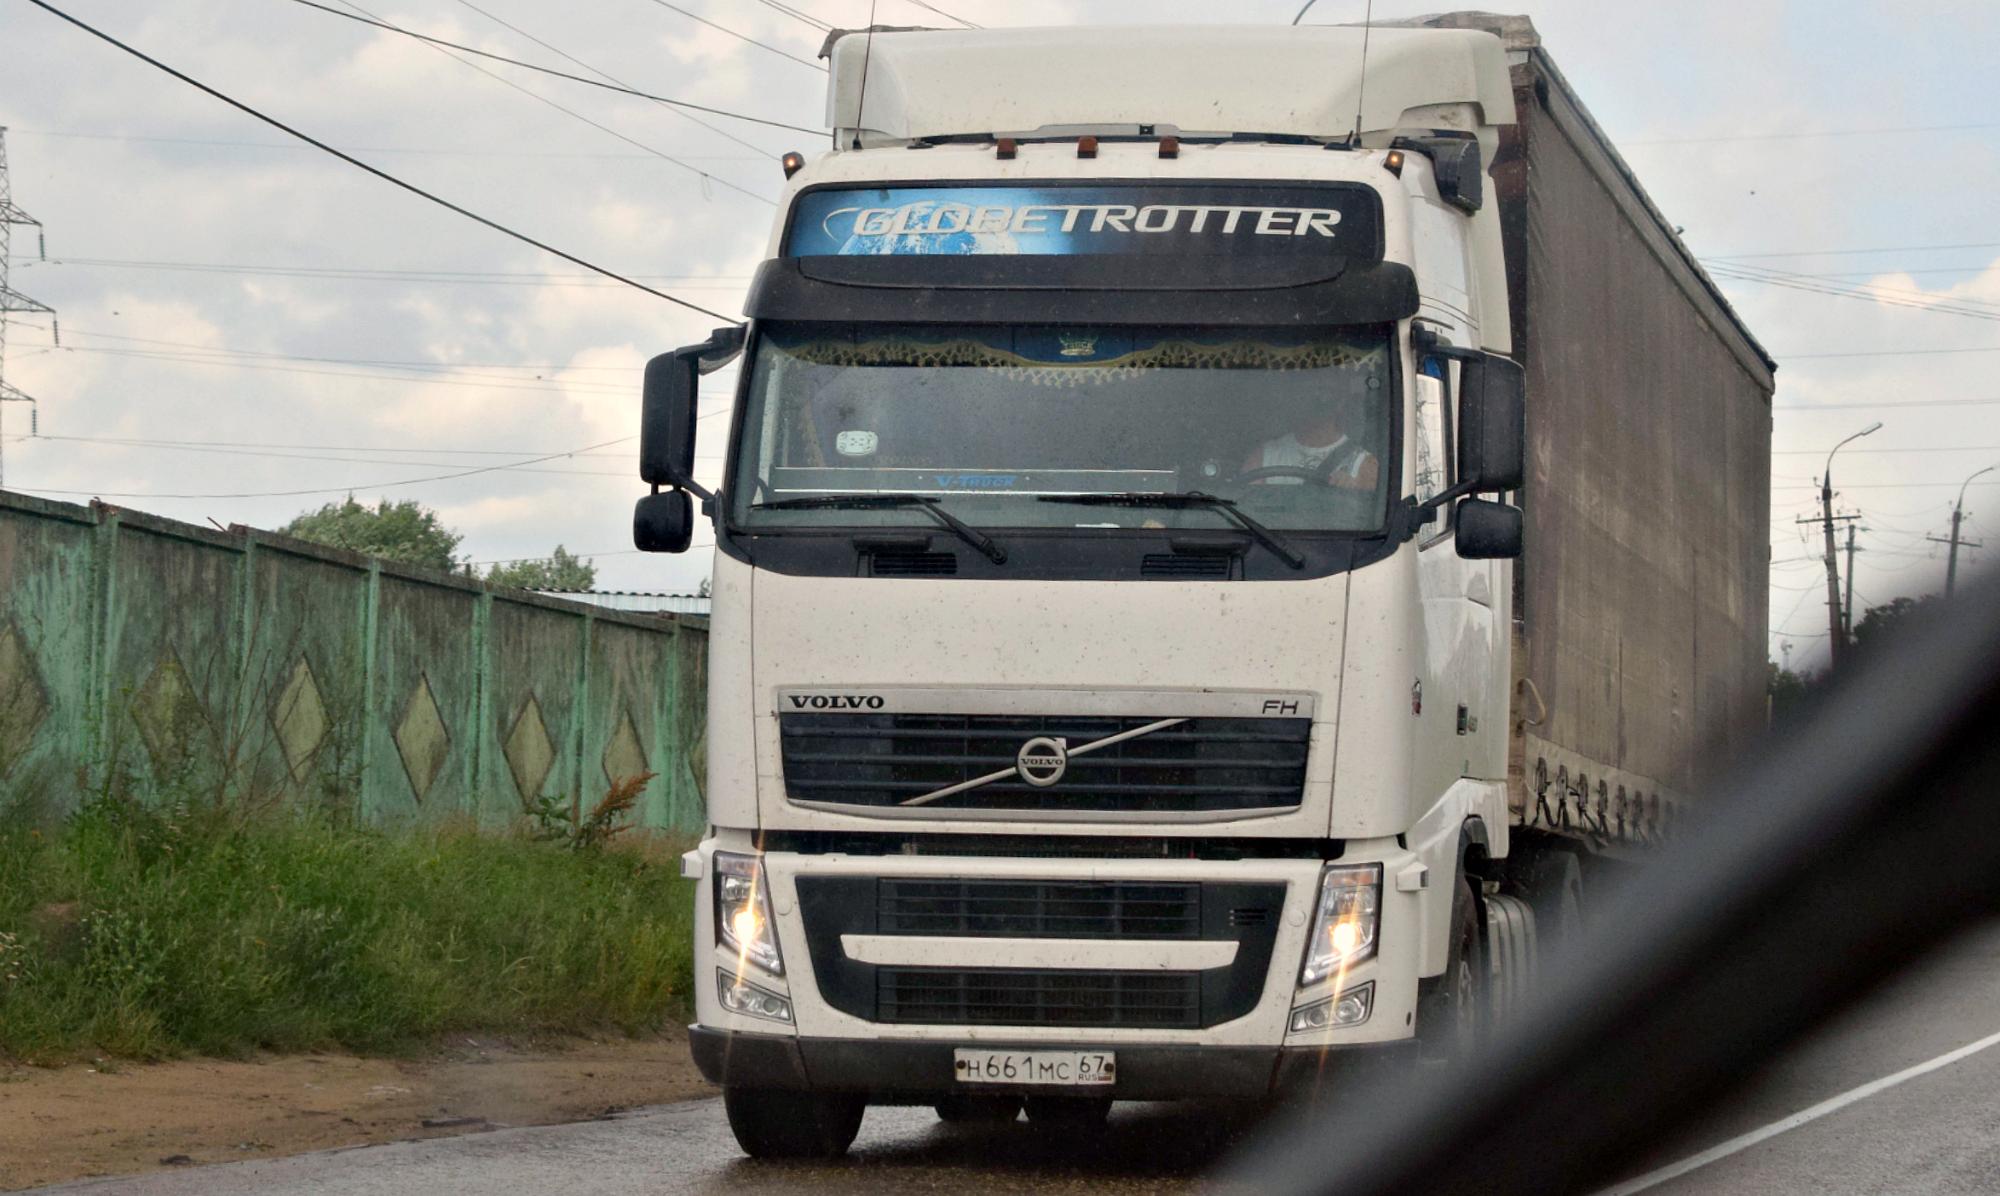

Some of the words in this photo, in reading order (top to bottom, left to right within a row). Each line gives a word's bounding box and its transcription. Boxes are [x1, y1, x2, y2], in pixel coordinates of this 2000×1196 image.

[853, 204, 1342, 238] GLOBETROTTER
[788, 695, 884, 709] VOLVO
[1262, 700, 1298, 714] FH
[1021, 758, 1063, 766] VOLVO
[1079, 1055, 1105, 1073] 67
[1078, 1073, 1098, 1081] RUS
